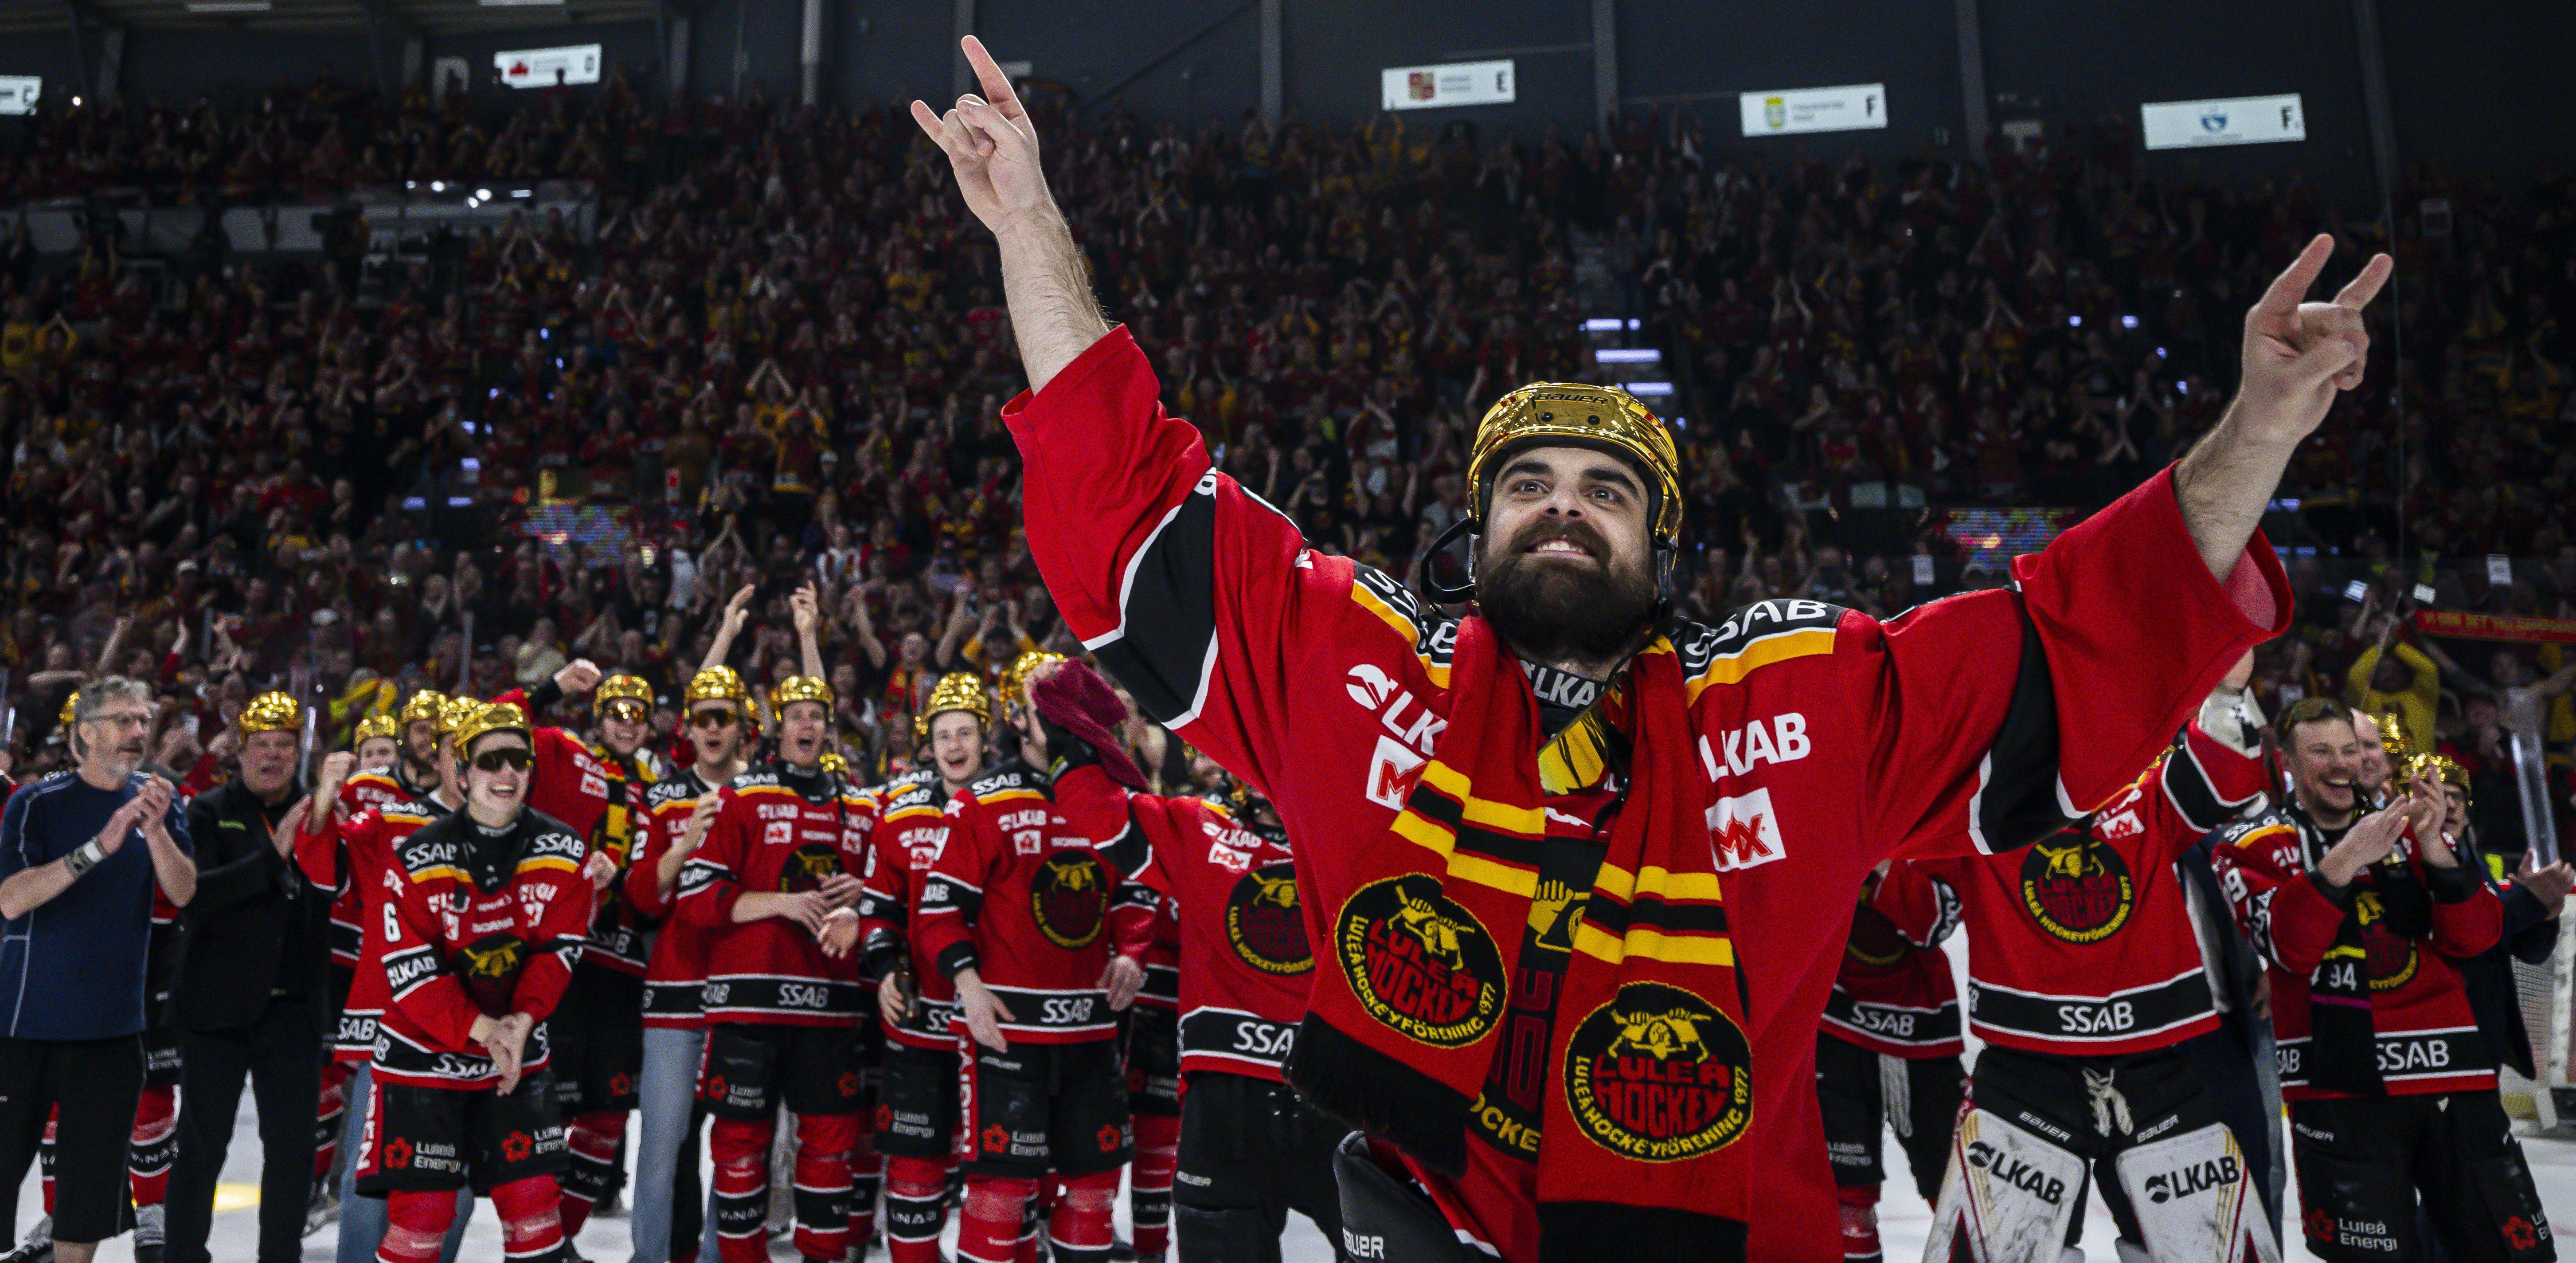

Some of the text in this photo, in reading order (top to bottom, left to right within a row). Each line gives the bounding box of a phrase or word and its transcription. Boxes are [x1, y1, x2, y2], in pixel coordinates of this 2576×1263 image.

[1496, 70, 1507, 93] E
[1866, 95, 1876, 118] F
[1535, 393, 1608, 405] BAUER
[1364, 569, 1459, 654] SSB
[1533, 666, 1605, 708] LKA
[1381, 690, 1449, 757] LK
[1699, 712, 1811, 783] LKAB
[972, 773, 1021, 794] SSAB
[532, 833, 585, 859] SSAB
[1218, 828, 1262, 848] LKAB
[1710, 812, 1774, 868] MX
[383, 902, 402, 943] 6
[1368, 918, 1479, 1000] LULEÅ
[778, 983, 829, 1008] SSAB
[1366, 942, 1474, 1024] HOCKEY
[926, 1009, 953, 1032] SS
[1040, 998, 1095, 1023] SSAB
[1851, 1004, 1915, 1036] SSAB
[2059, 1001, 2134, 1033] SSAB
[338, 1018, 377, 1040] SAB
[1233, 1021, 1294, 1055] SSA
[432, 1054, 497, 1078] SSA
[1593, 1053, 1731, 1088] LULEÅ
[1734, 1066, 1748, 1105] 1977
[1593, 1080, 1729, 1138] HOCKEY
[2018, 1111, 2071, 1143] BAUER
[1992, 1152, 2065, 1204] LKAB
[2171, 1156, 2240, 1199] LKAB
[2339, 1218, 2387, 1236] Luleå
[2341, 1233, 2398, 1252] Energi
